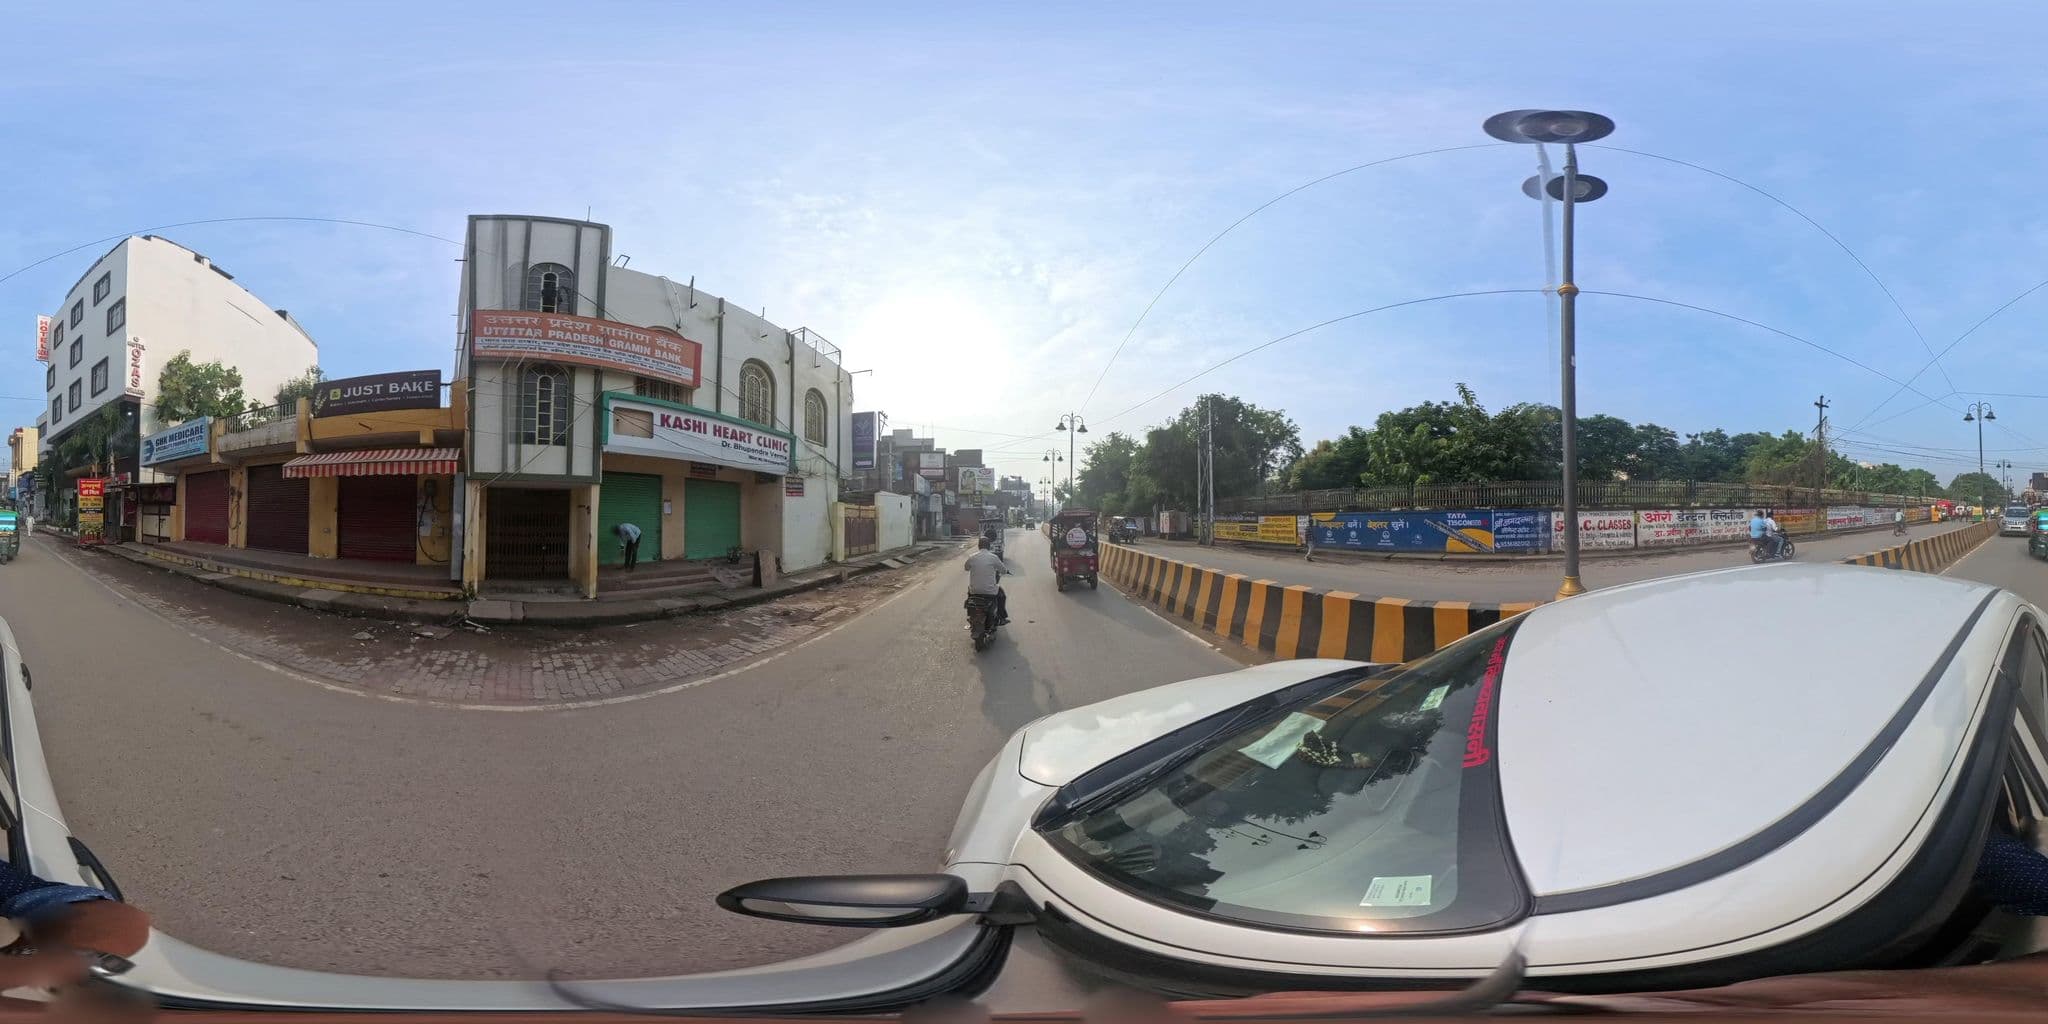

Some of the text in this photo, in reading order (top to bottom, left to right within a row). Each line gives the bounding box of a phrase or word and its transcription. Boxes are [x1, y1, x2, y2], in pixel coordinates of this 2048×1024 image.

[548, 330, 604, 345] PRADESH
[609, 339, 651, 355] GRAMIN
[655, 349, 682, 364] BANK
[343, 380, 434, 398] JUST BAKE
[169, 424, 204, 442] MEDICARE
[660, 413, 788, 453] KASHI HEART CLINIC
[721, 440, 732, 449] Dr.
[733, 442, 769, 456] Bhupendra
[1597, 519, 1632, 531] CLASSES
